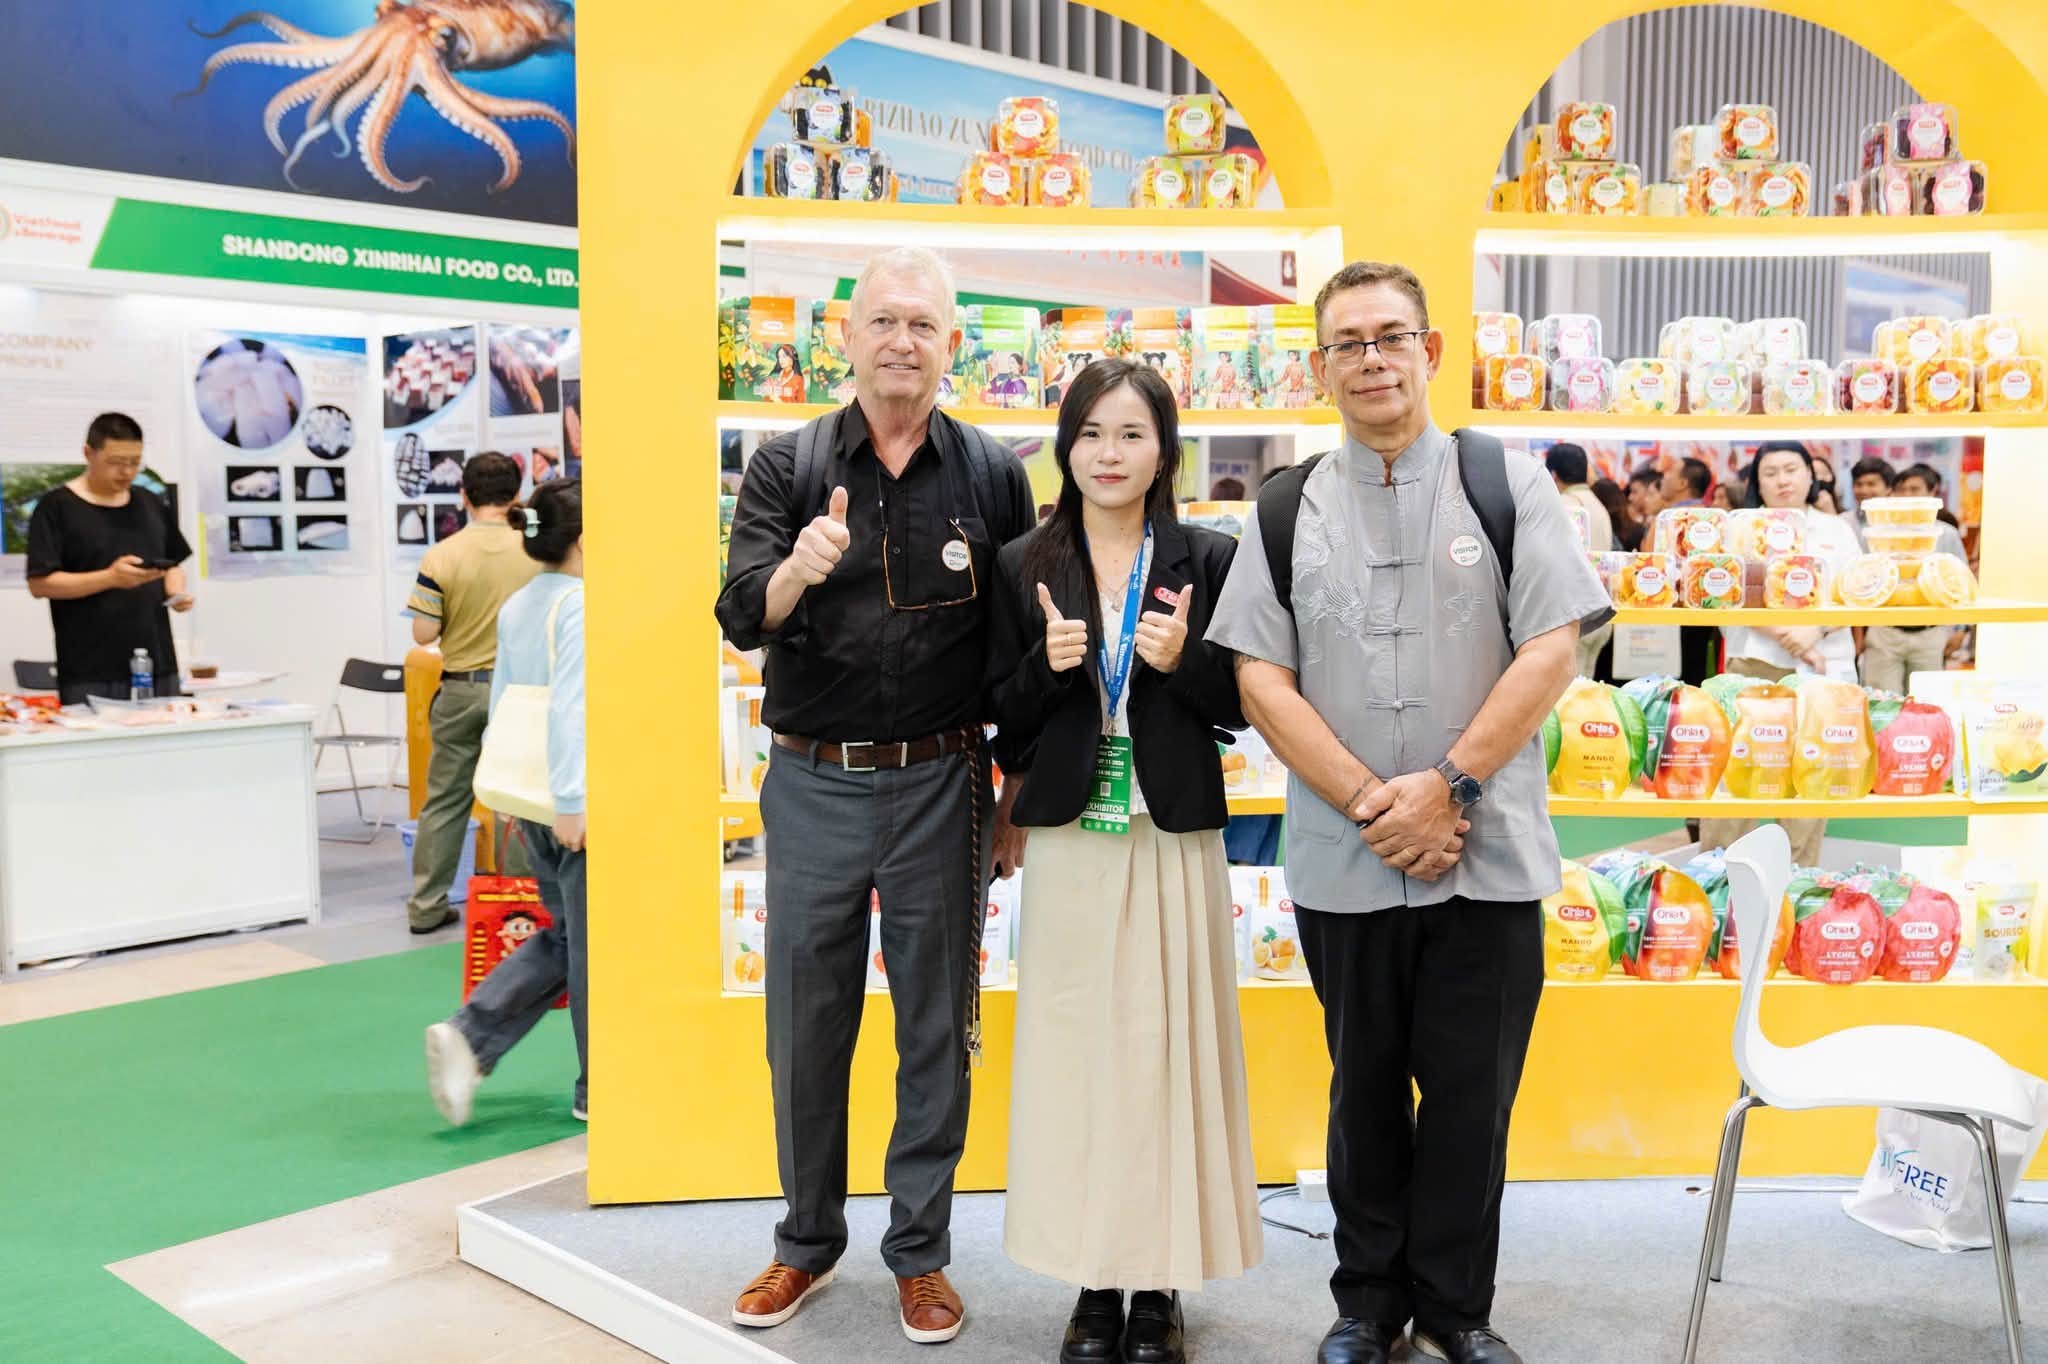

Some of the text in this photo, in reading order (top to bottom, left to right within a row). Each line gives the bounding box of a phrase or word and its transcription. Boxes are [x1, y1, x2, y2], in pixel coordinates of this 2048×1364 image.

[222, 234, 579, 287] SHANDONG XINRIHAI FOOD CO., LTD.
